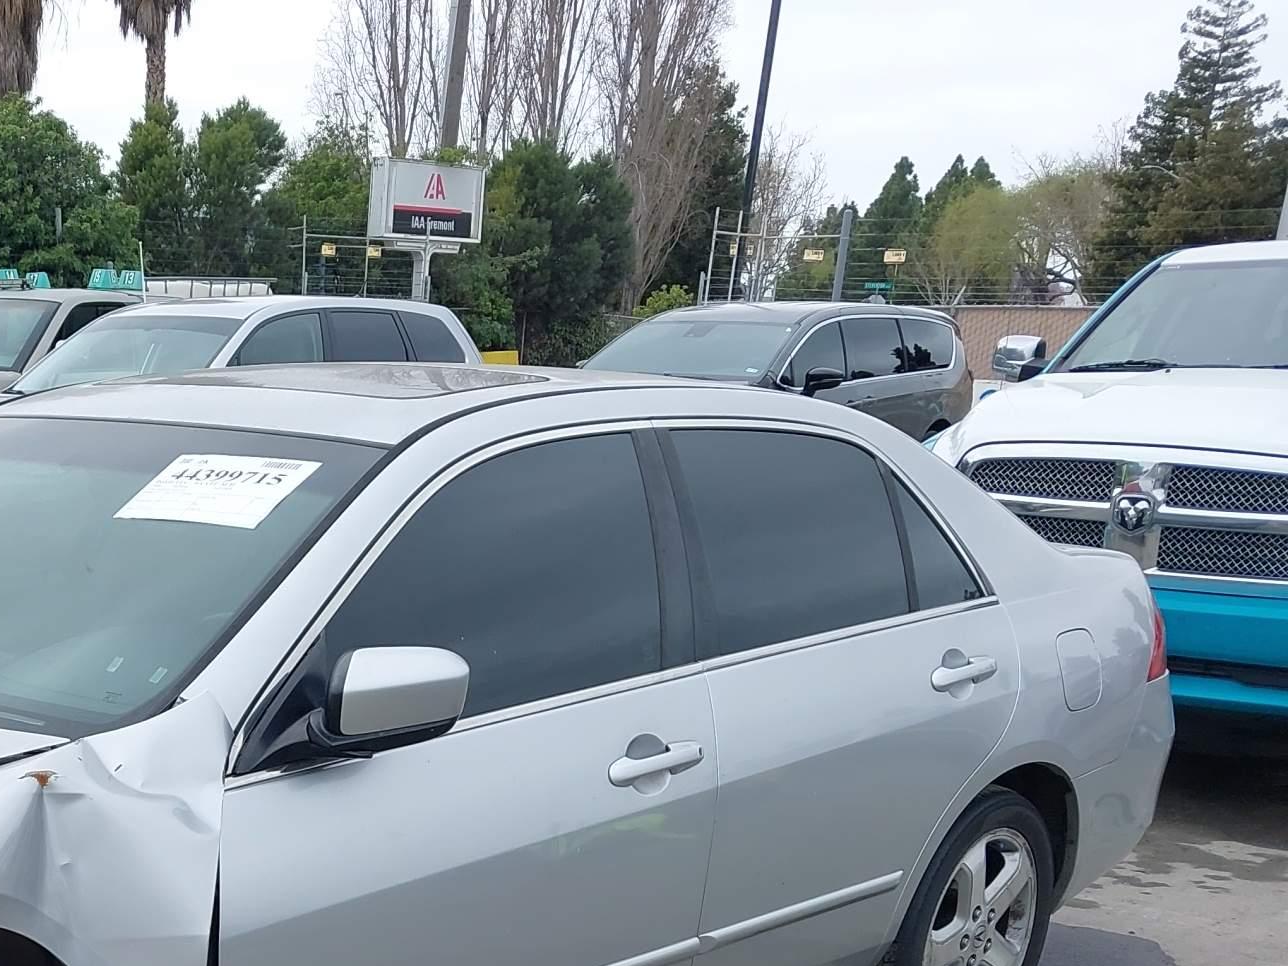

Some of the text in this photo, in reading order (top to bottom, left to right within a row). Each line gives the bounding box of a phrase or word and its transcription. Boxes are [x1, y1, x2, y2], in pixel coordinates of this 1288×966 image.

[411, 215, 455, 231] IAA Fremont
[124, 271, 135, 285] 13
[171, 468, 289, 485] 44399715
